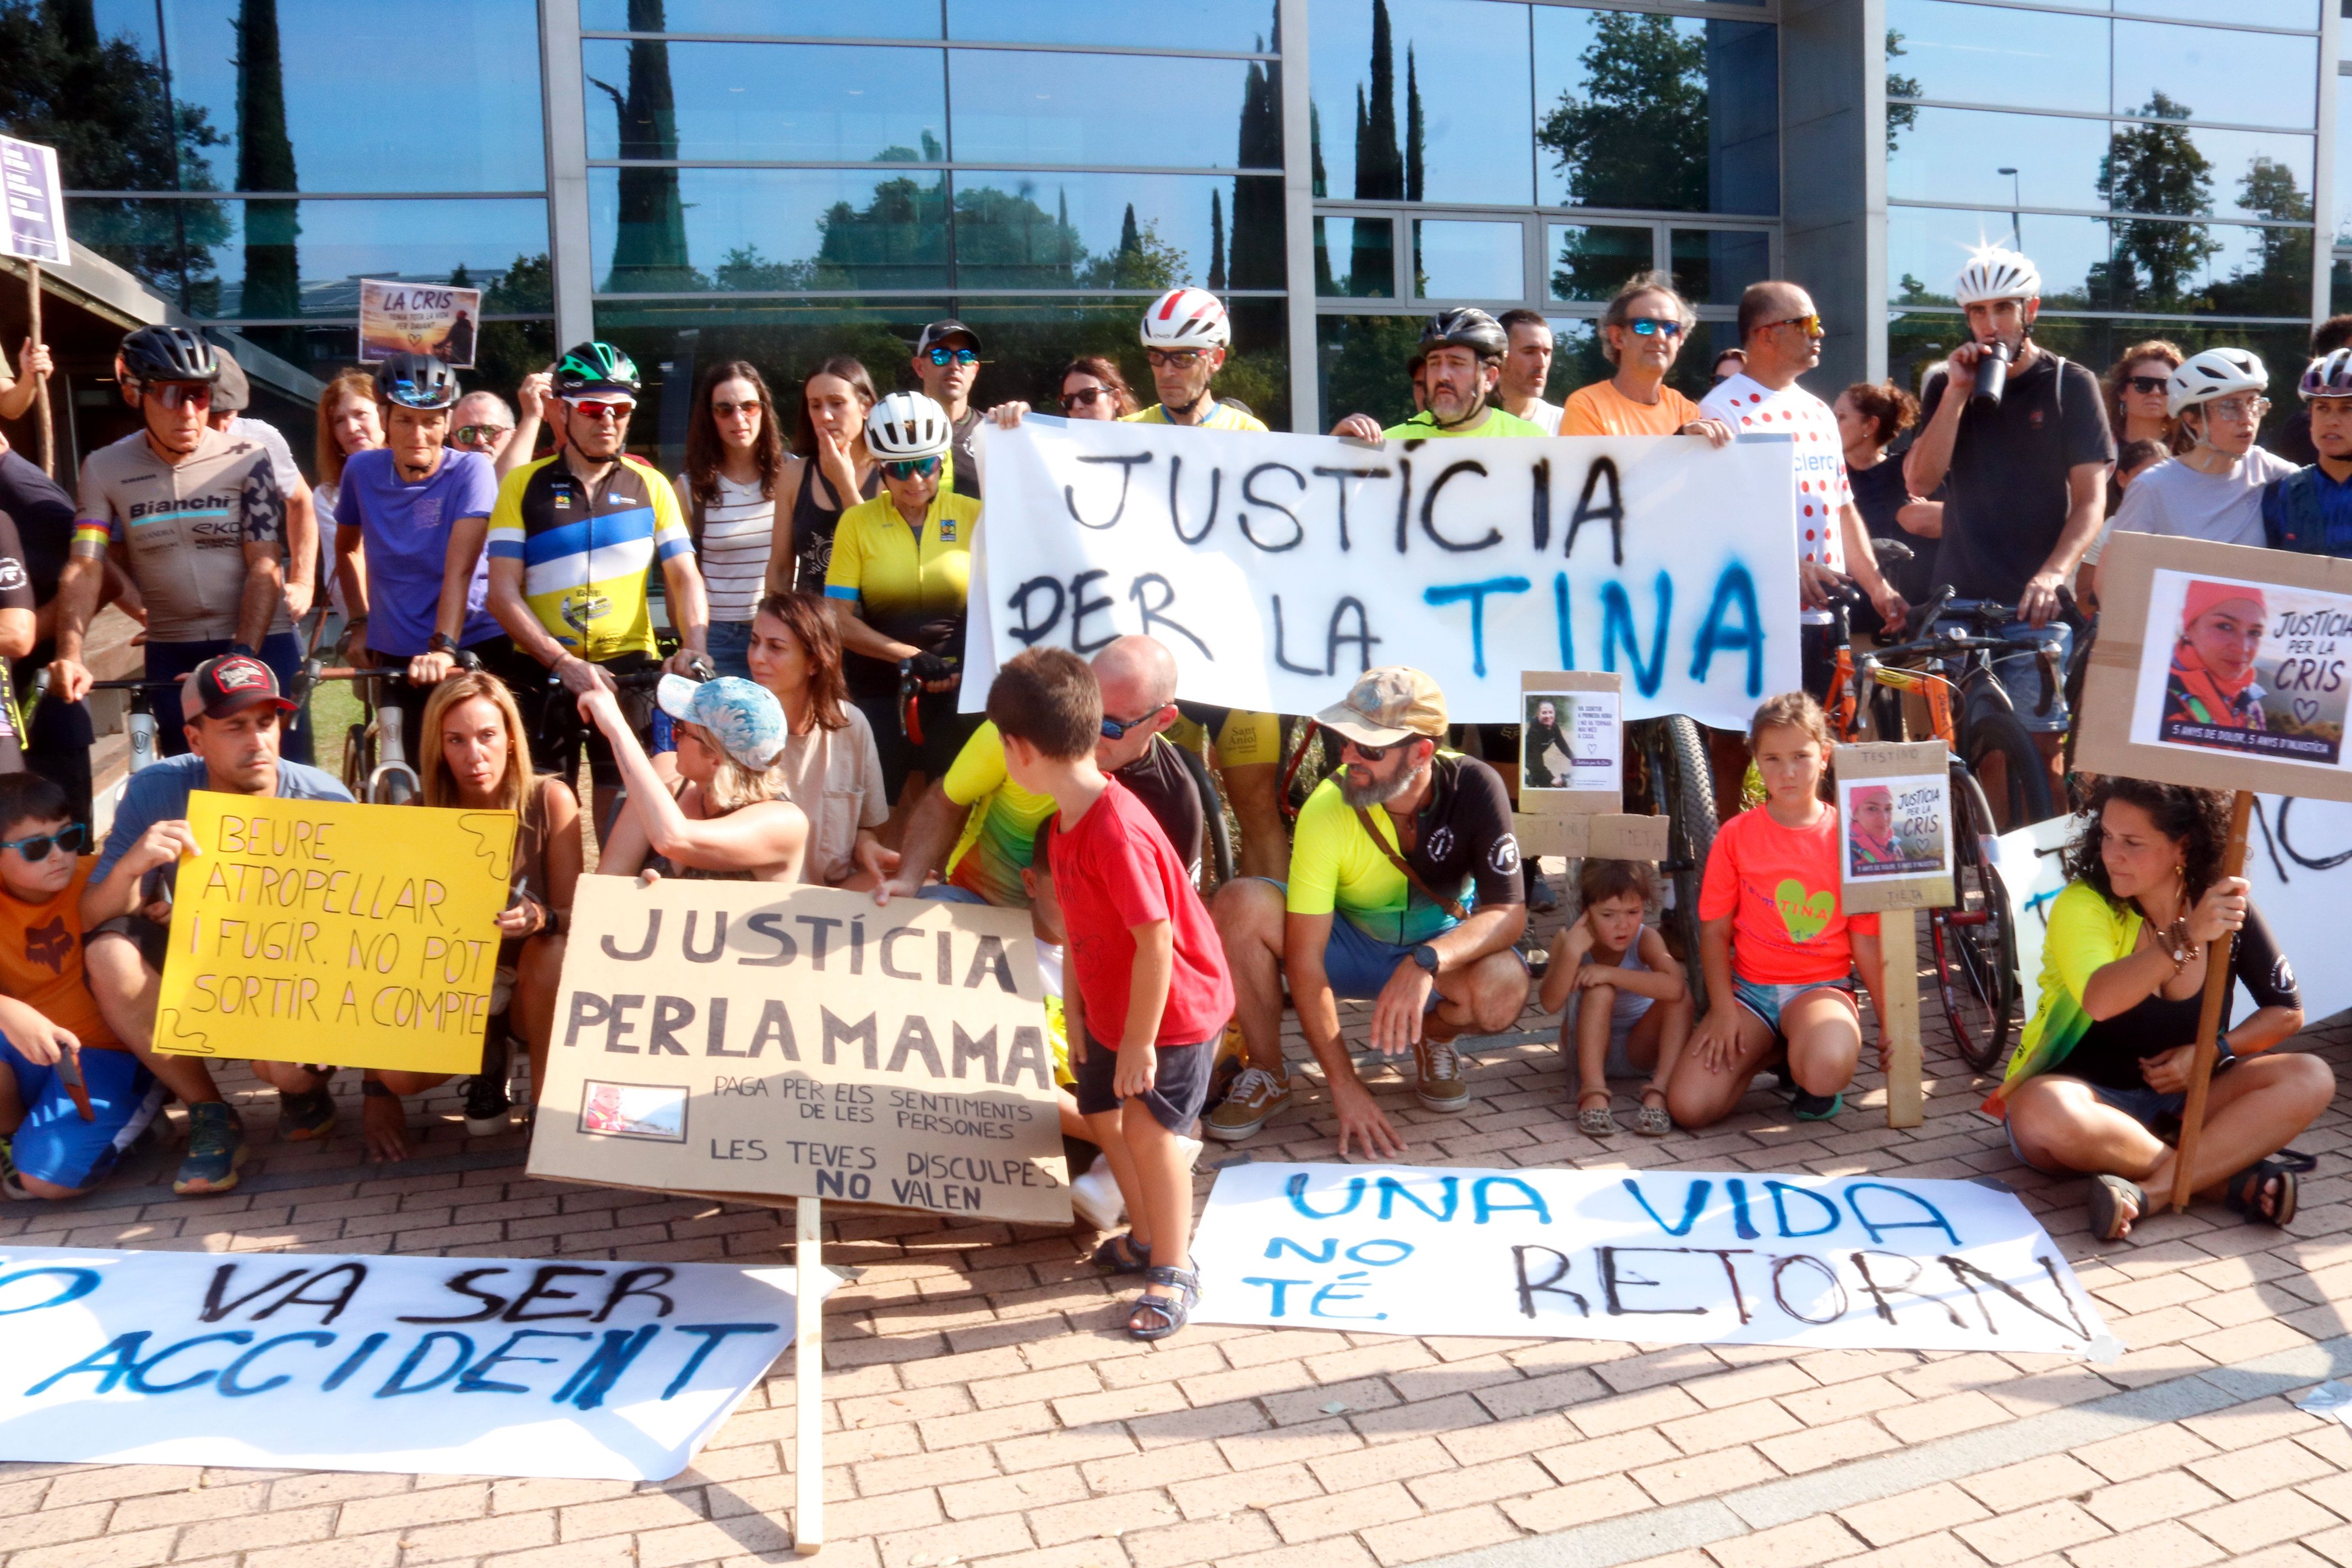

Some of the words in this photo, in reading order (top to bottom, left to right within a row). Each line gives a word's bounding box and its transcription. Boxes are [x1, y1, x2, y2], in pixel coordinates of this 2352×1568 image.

[382, 291, 405, 311] LA
[411, 290, 454, 310] CRIS
[1794, 453, 1835, 471] clerc
[129, 496, 230, 519] Bianchi
[1007, 569, 1215, 662] PER
[1272, 594, 1381, 677] LA
[1423, 558, 1768, 700] TINA
[2286, 639, 2313, 654] PER
[2317, 640, 2335, 655] LA
[2274, 657, 2345, 693] CRIS
[1228, 733, 1257, 745] Aniol
[1232, 727, 1255, 736] Sant
[2171, 724, 2180, 735] 5
[2180, 725, 2203, 738] ANYS
[2204, 728, 2217, 740] DE
[2248, 734, 2256, 744] 5
[2257, 736, 2279, 748] ANYS
[1903, 814, 1939, 837] CRIS
[1907, 807, 1919, 815] PER
[1921, 806, 1931, 814] LA
[202, 861, 447, 927] ATROPELLAR
[1781, 899, 1829, 921] TINA
[347, 928, 400, 974] NO
[600, 908, 1019, 994] JUSTÍCIA
[190, 973, 320, 1022] SORTIR
[335, 981, 360, 1027] A
[371, 986, 490, 1036] COMPTE
[563, 990, 696, 1057] PER
[705, 997, 802, 1062] LA
[820, 1003, 1051, 1091] MAMA
[714, 1075, 769, 1098] PAGA
[783, 1078, 825, 1101] PER
[835, 1082, 874, 1104] ELS
[888, 1088, 1033, 1122] SENTIMENTS
[799, 1103, 826, 1120] DE
[835, 1106, 875, 1123] LES
[896, 1110, 1015, 1140] PERSONES
[710, 1137, 768, 1162] LES
[785, 1140, 878, 1170] TEVES
[906, 1152, 1060, 1190] DISCULPES
[816, 1168, 872, 1201] NO
[891, 1178, 982, 1211] VALEN
[1285, 1171, 1555, 1227] UNA
[1621, 1177, 1964, 1248] VIDA
[1262, 1235, 1417, 1269] NO
[197, 1261, 369, 1325] VA
[395, 1264, 676, 1325] SER
[1242, 1270, 1390, 1321] TÉ
[1510, 1242, 2093, 1342] RETORN
[24, 1322, 781, 1410] ACCIDENT
